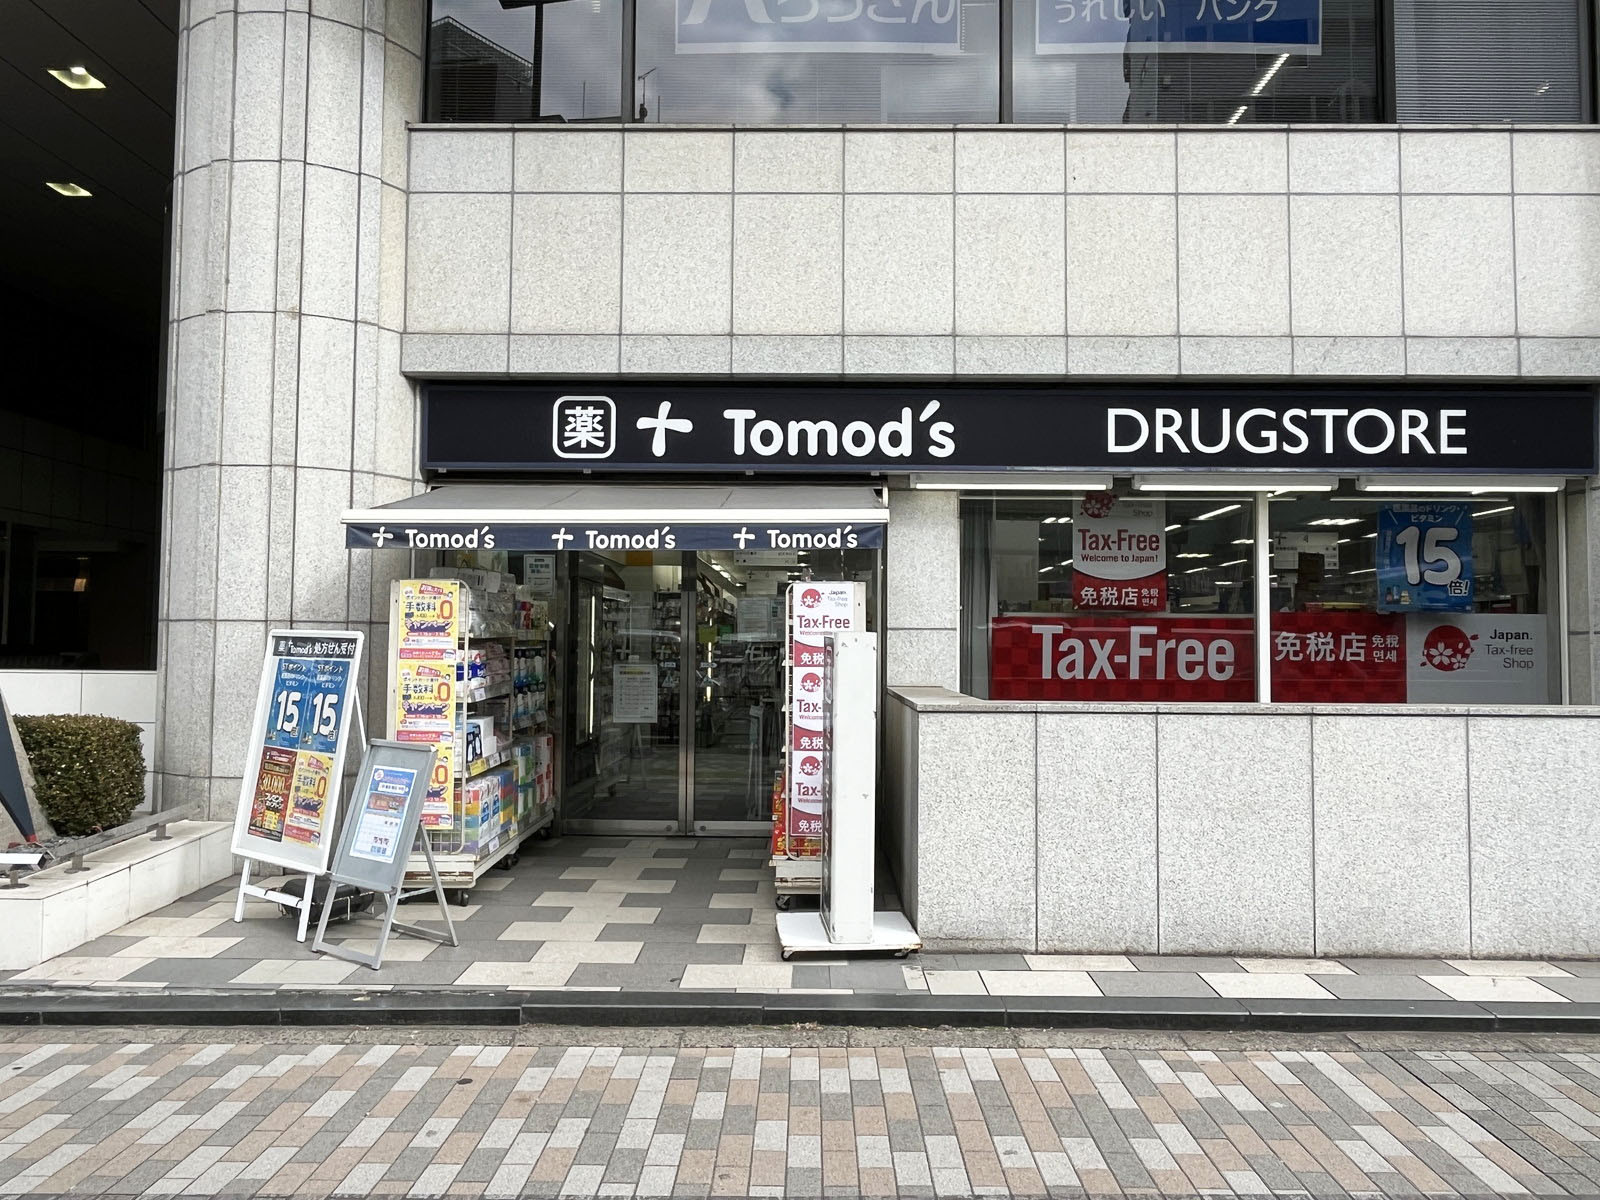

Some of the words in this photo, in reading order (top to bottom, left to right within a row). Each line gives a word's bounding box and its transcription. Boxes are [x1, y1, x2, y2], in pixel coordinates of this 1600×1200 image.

[563, 407, 604, 449] 薬
[723, 400, 955, 458] Tomod's
[1107, 407, 1468, 455] DRUGSTORE
[404, 526, 495, 549] Tomod's
[585, 526, 676, 549] Tomod's
[767, 525, 858, 548] Tomod's
[1078, 528, 1160, 551] Tax-Free
[1081, 554, 1118, 562] Welcome
[1121, 554, 1129, 562] to
[1131, 554, 1158, 563] Japan!
[1396, 526, 1462, 586] 15
[1080, 586, 1138, 606] 免税店
[797, 615, 850, 629] Tax-Free
[1274, 631, 1366, 662] 免税店
[1489, 629, 1533, 642] Japan.
[1032, 624, 1235, 681] Tax-Free
[1372, 649, 1397, 663] 면세
[1485, 644, 1534, 655] Tax-free
[1503, 657, 1534, 670] Shop
[277, 690, 302, 733] 15
[313, 692, 339, 737] 15
[797, 700, 823, 713] Tax-
[796, 783, 823, 796] Tax-
